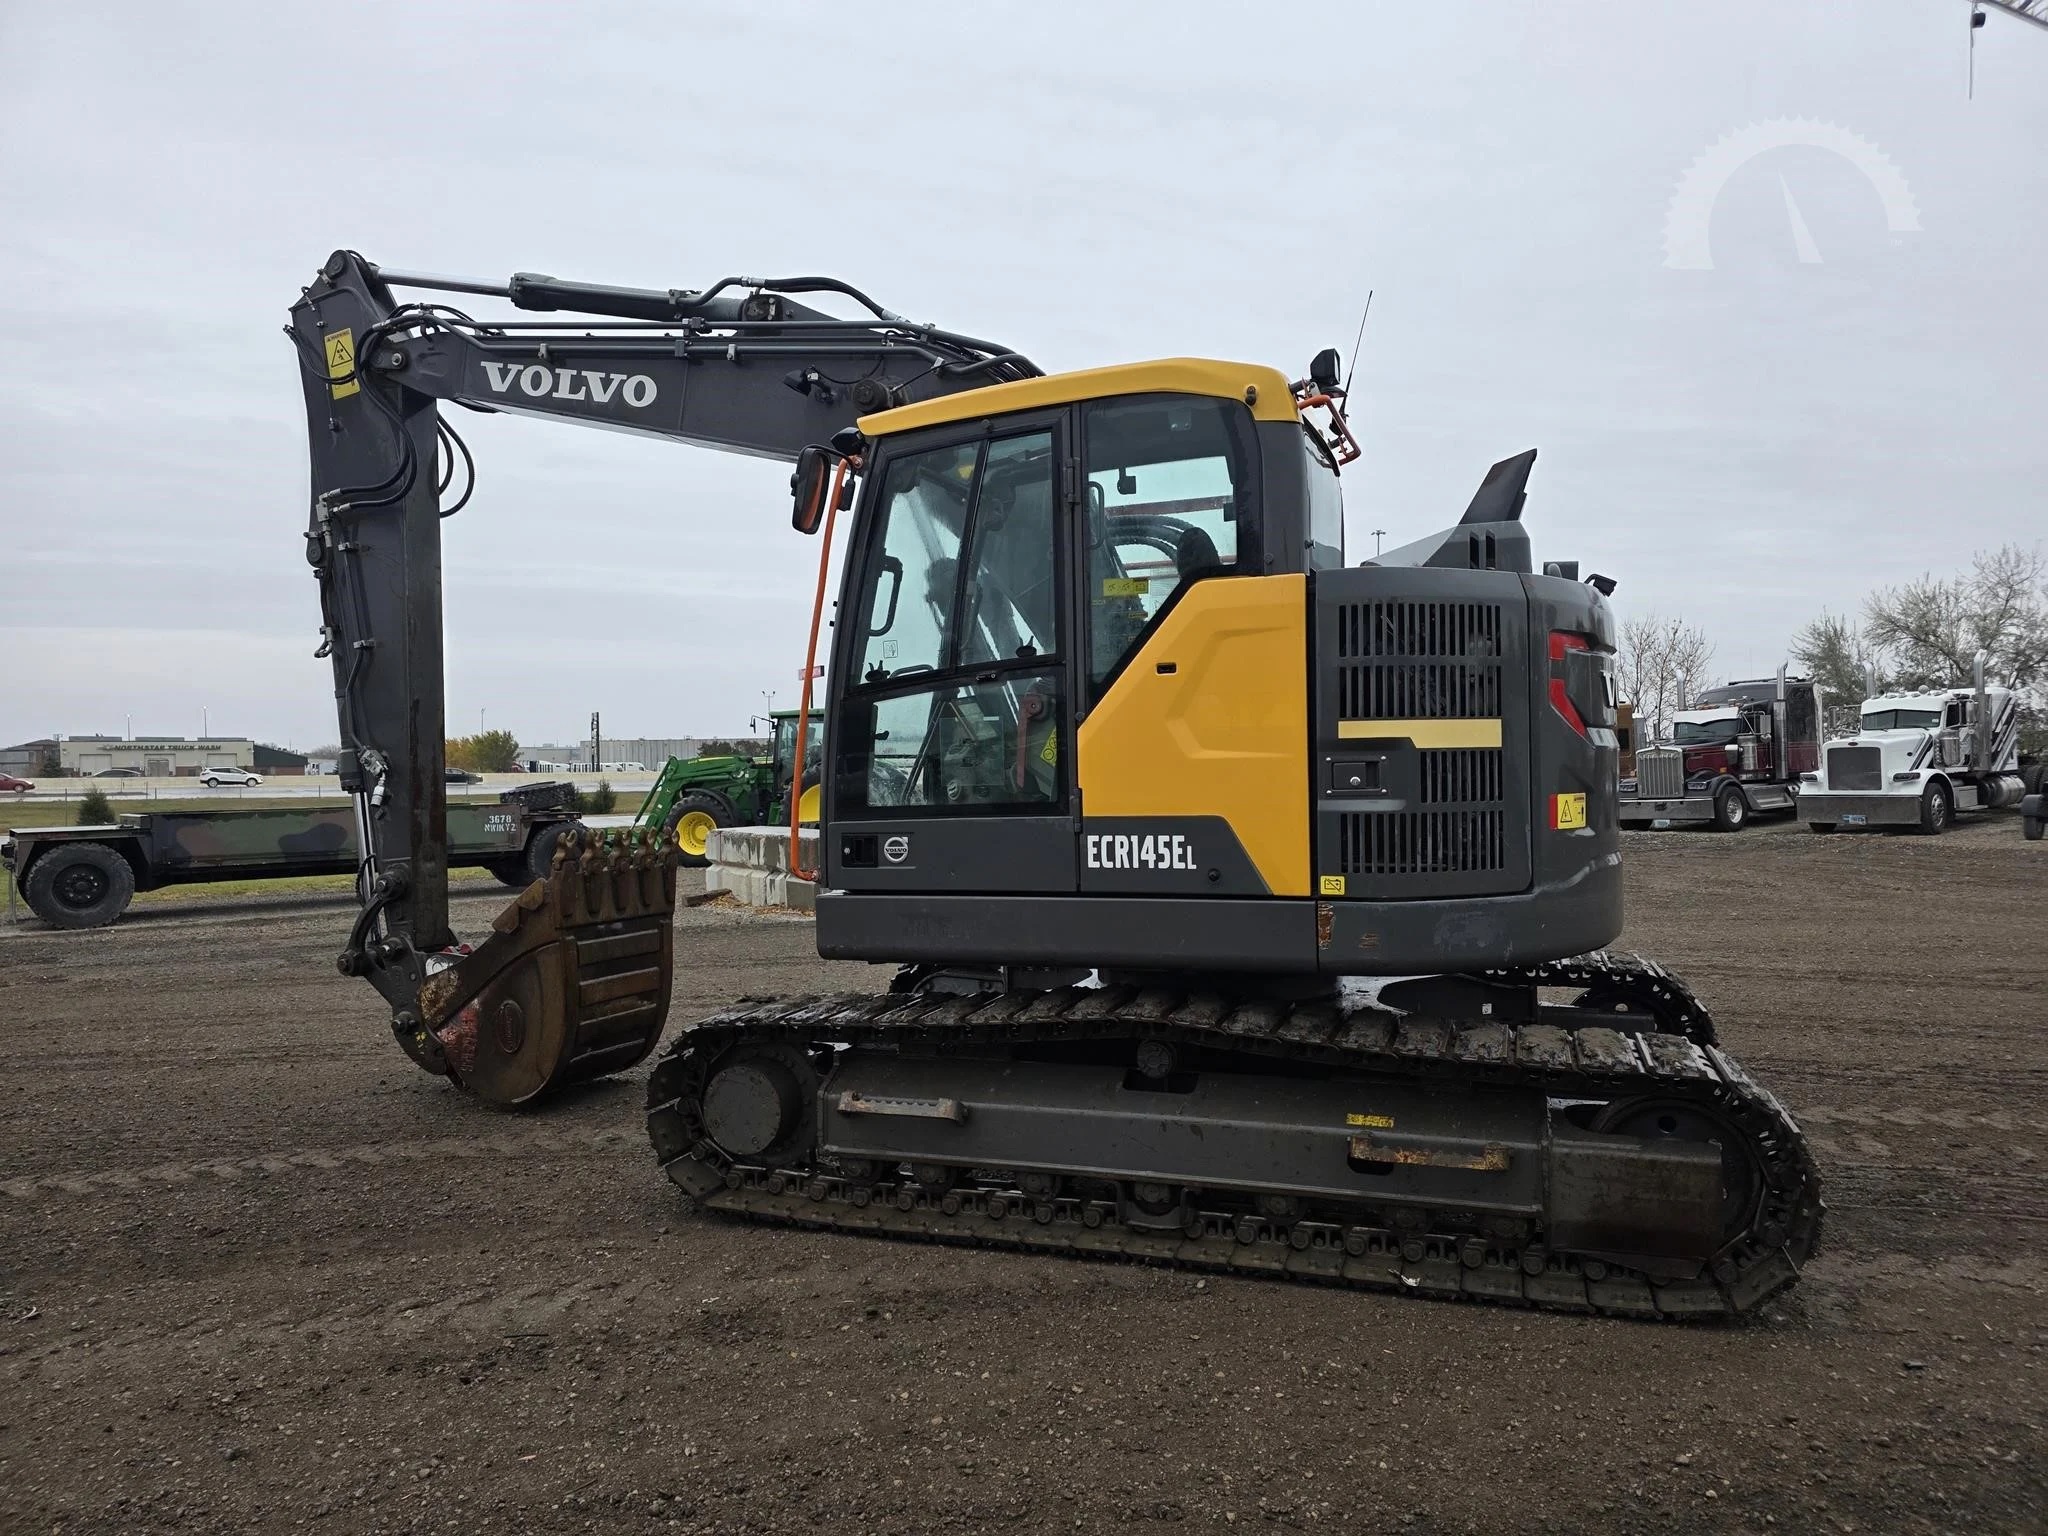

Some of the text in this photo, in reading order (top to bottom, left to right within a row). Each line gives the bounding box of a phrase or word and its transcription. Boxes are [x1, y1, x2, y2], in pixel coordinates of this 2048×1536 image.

[480, 361, 658, 408] VOLVO
[488, 814, 512, 824] 3678
[1087, 835, 1197, 870] ECR145EL
